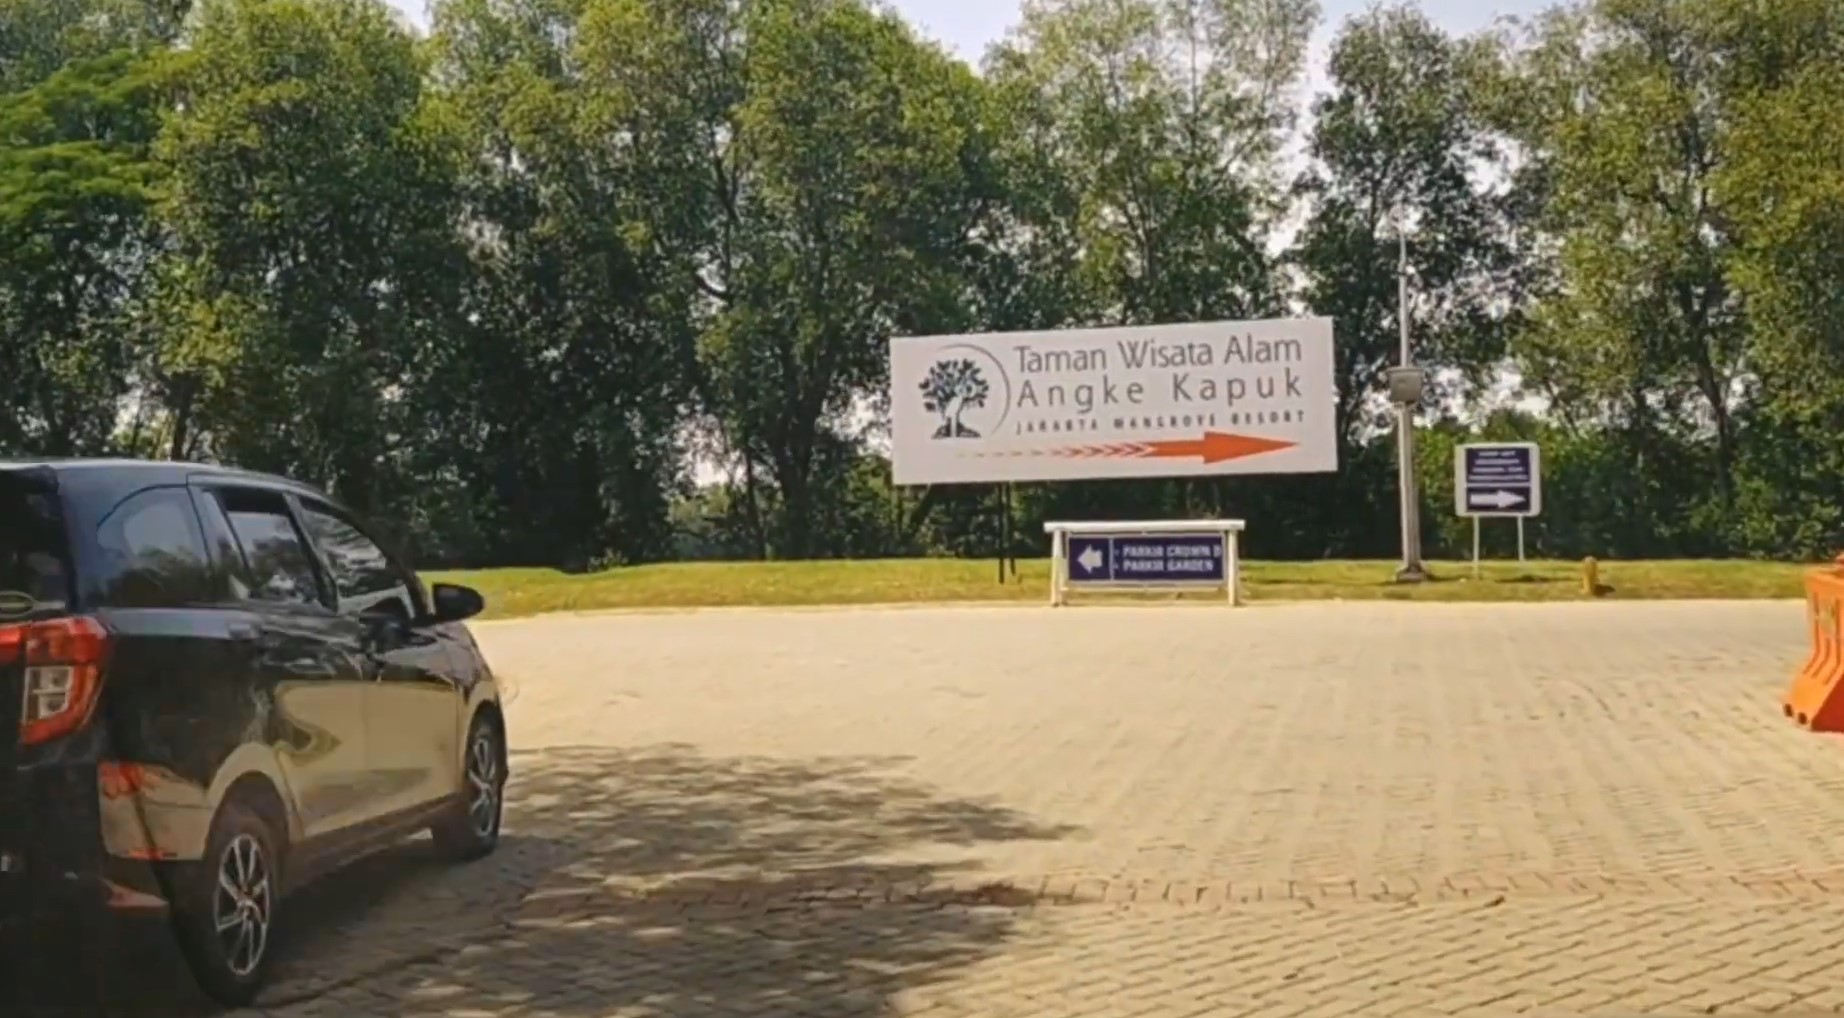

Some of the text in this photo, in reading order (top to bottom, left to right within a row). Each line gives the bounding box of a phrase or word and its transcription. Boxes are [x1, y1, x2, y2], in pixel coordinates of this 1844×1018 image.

[1012, 332, 1302, 373] Taman Wisata Alam
[1016, 367, 1302, 414] Angke Kapuk
